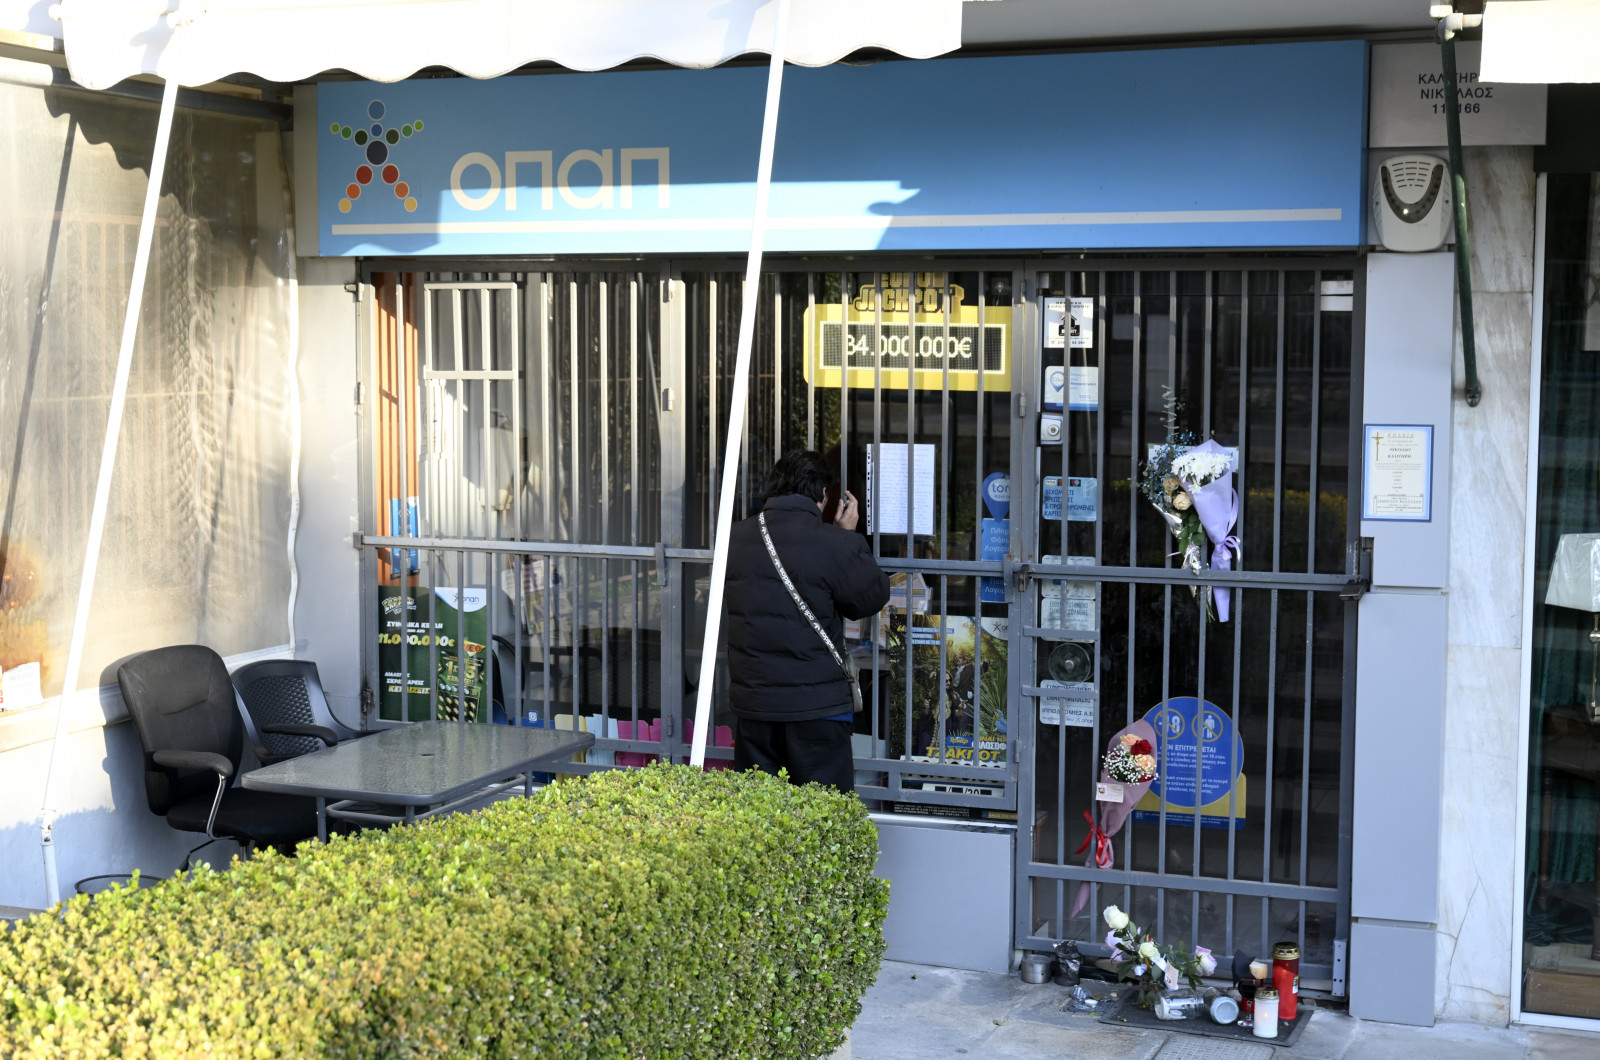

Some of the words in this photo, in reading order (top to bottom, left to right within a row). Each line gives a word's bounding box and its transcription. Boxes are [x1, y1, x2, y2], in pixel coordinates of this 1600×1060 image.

[1420, 87, 1494, 99] ΝΙΚΛΑΟΣ
[1432, 103, 1481, 114] 11166
[1042, 708, 1082, 716] ΙΠΠΟΔΟΜΙΕΣ
[1175, 745, 1217, 753] ΕΠΙΤΡΕΕΤΑΙ
